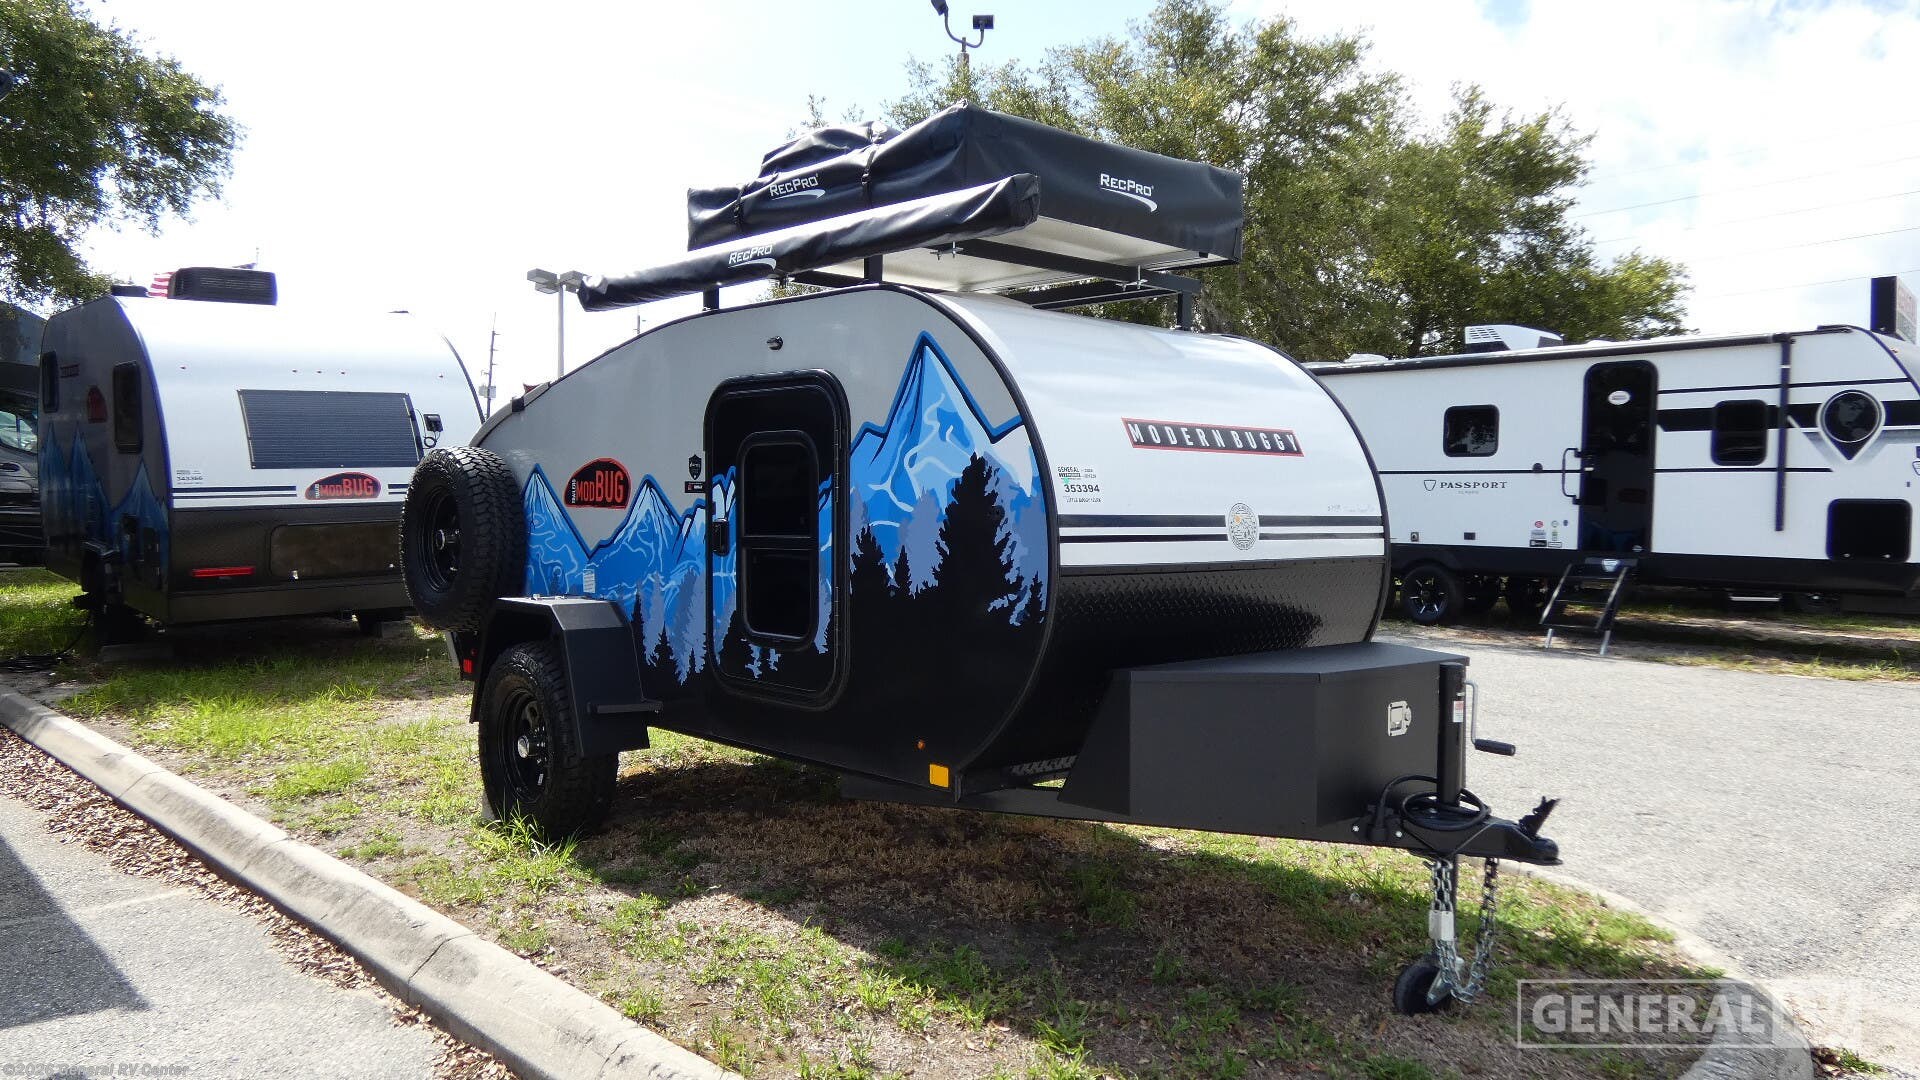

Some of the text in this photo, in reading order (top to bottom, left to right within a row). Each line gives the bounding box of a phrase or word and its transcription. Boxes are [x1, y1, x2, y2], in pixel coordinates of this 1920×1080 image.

[1127, 423, 1298, 451] MODERN BUGGY
[1063, 484, 1100, 493] 353394
[1440, 481, 1507, 489] PASSPORT
